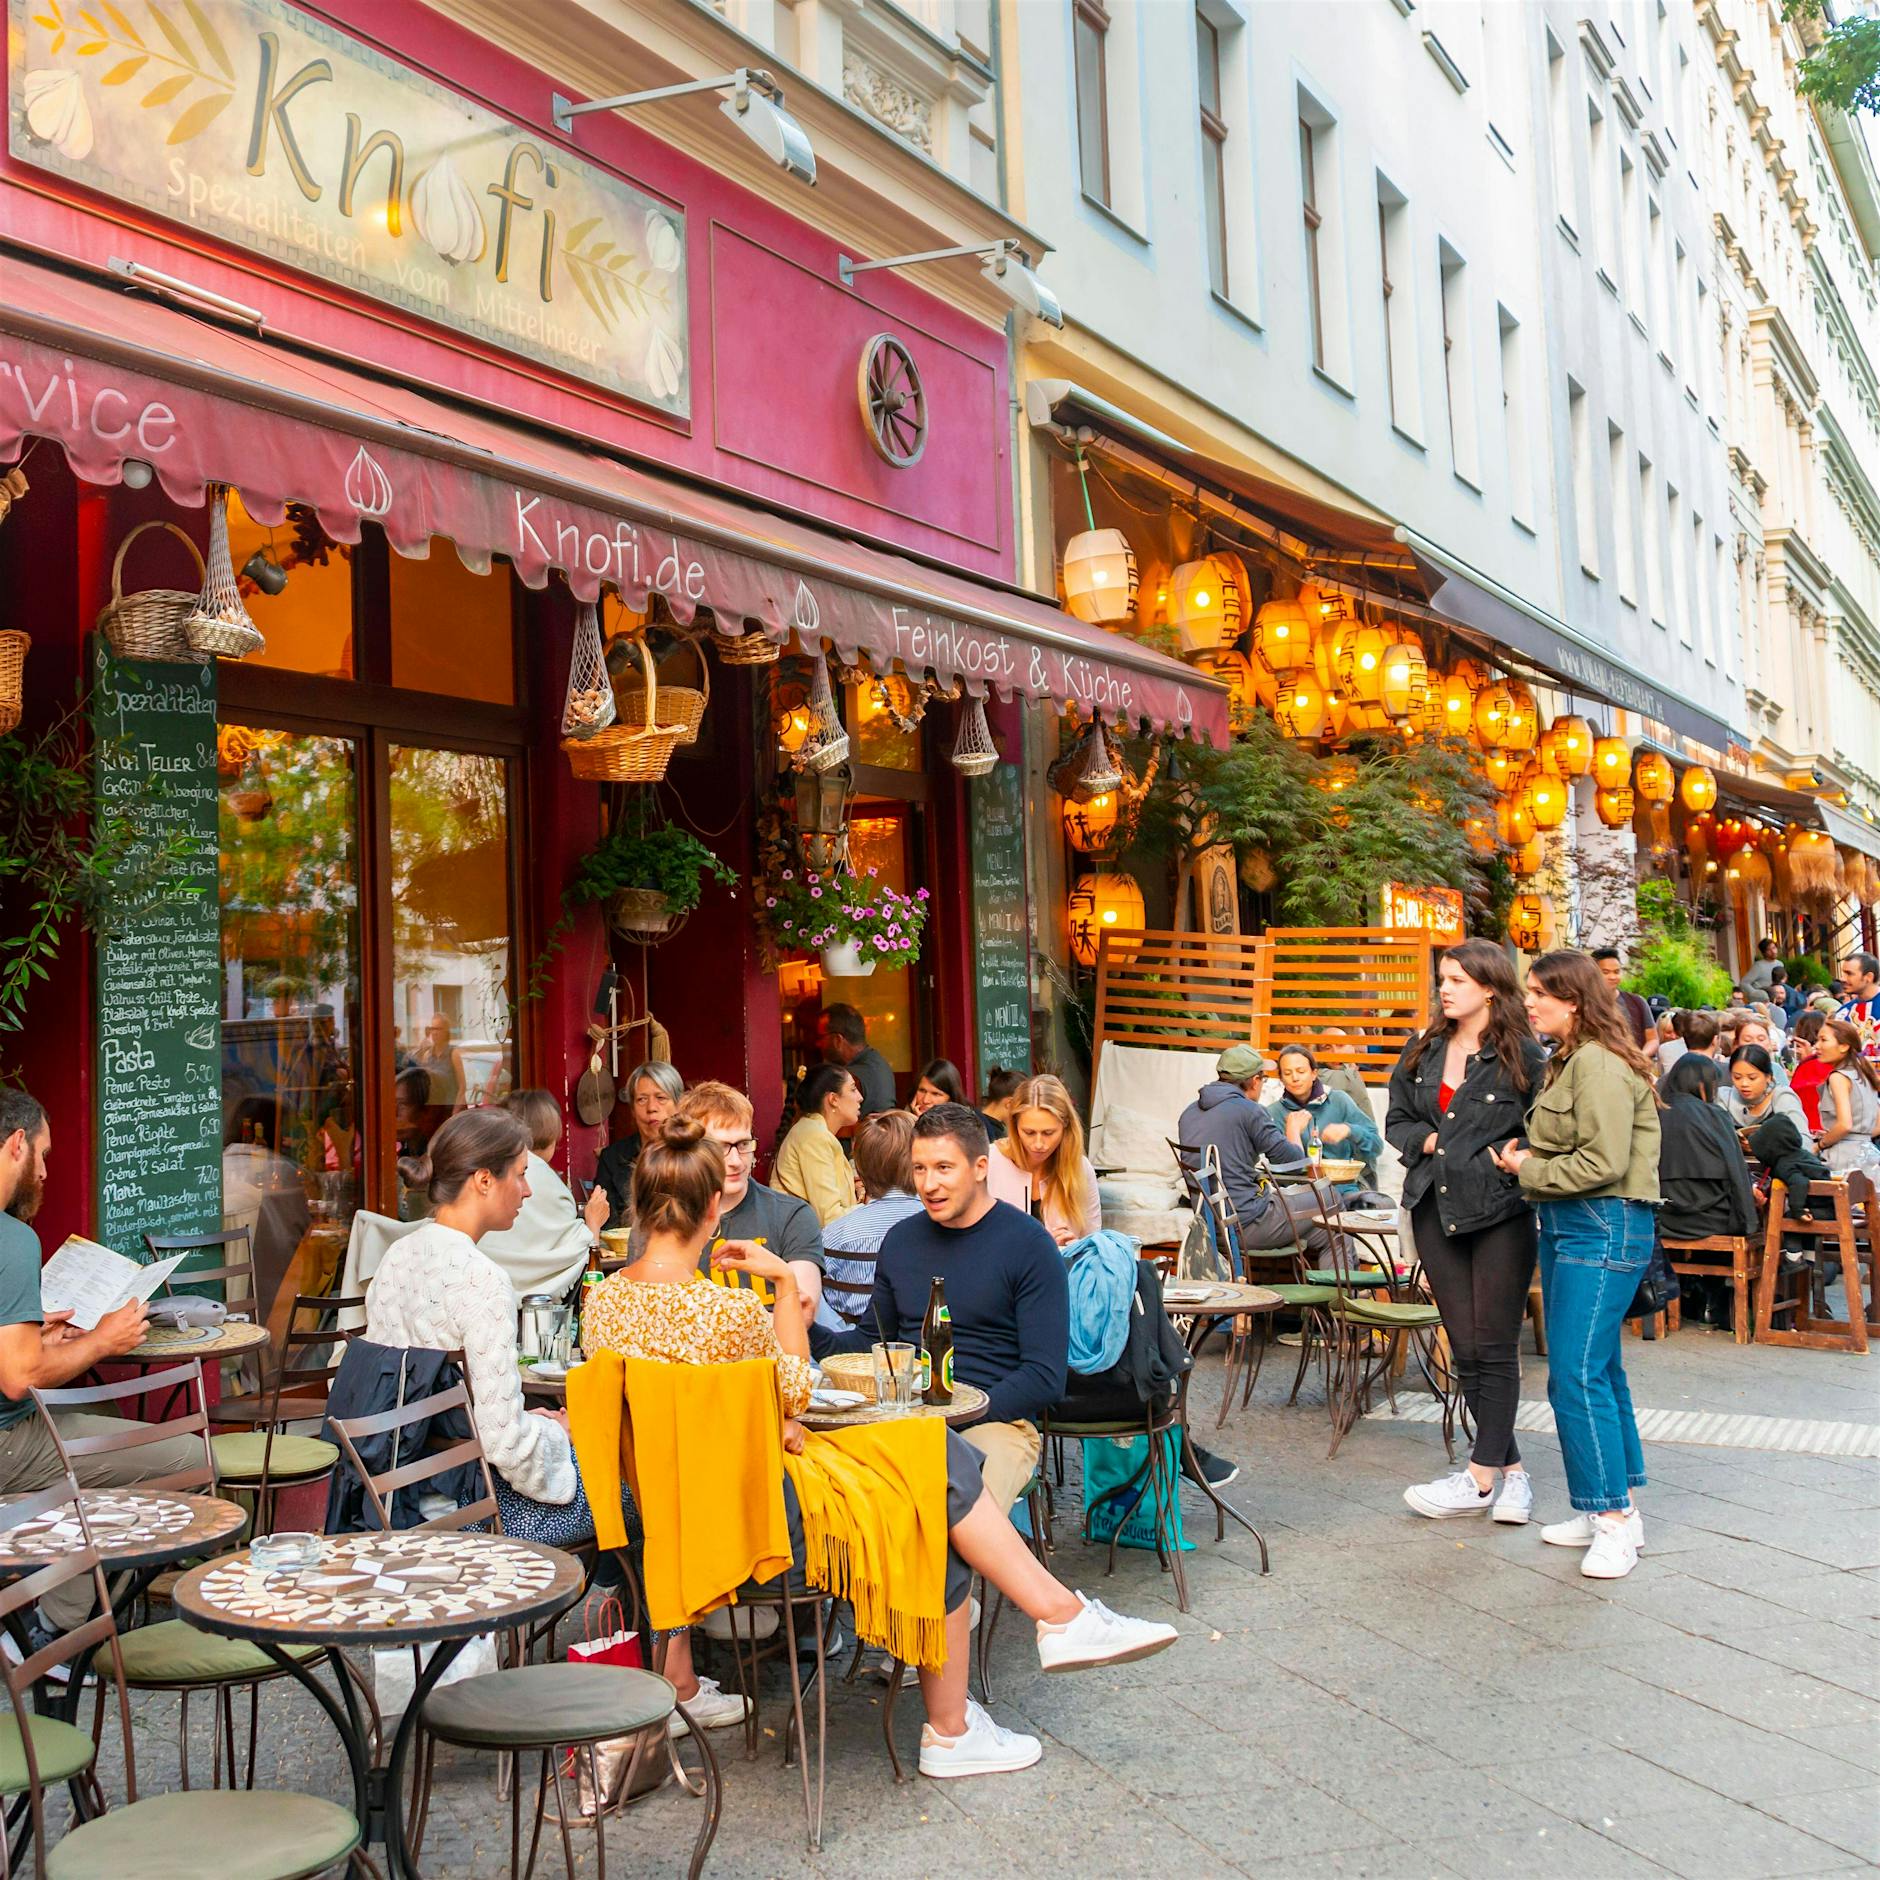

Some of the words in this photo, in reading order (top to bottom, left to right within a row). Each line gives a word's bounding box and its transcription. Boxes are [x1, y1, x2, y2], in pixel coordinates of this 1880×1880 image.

[167, 156, 366, 270] Spezialitäten
[394, 256, 451, 305] vom
[475, 284, 604, 365] Mittelmeer
[515, 490, 707, 600] Knofi.de
[892, 605, 1015, 676] Feinkost
[1028, 646, 1050, 691] &
[1062, 653, 1134, 709] Küche
[139, 742, 196, 773] TELLER
[101, 1038, 156, 1077] Pasta
[103, 1076, 137, 1097] Penne
[136, 1074, 171, 1092] Pesto
[103, 1126, 137, 1150] Penne
[135, 1122, 179, 1147] Rigate
[151, 1153, 186, 1174] Salat
